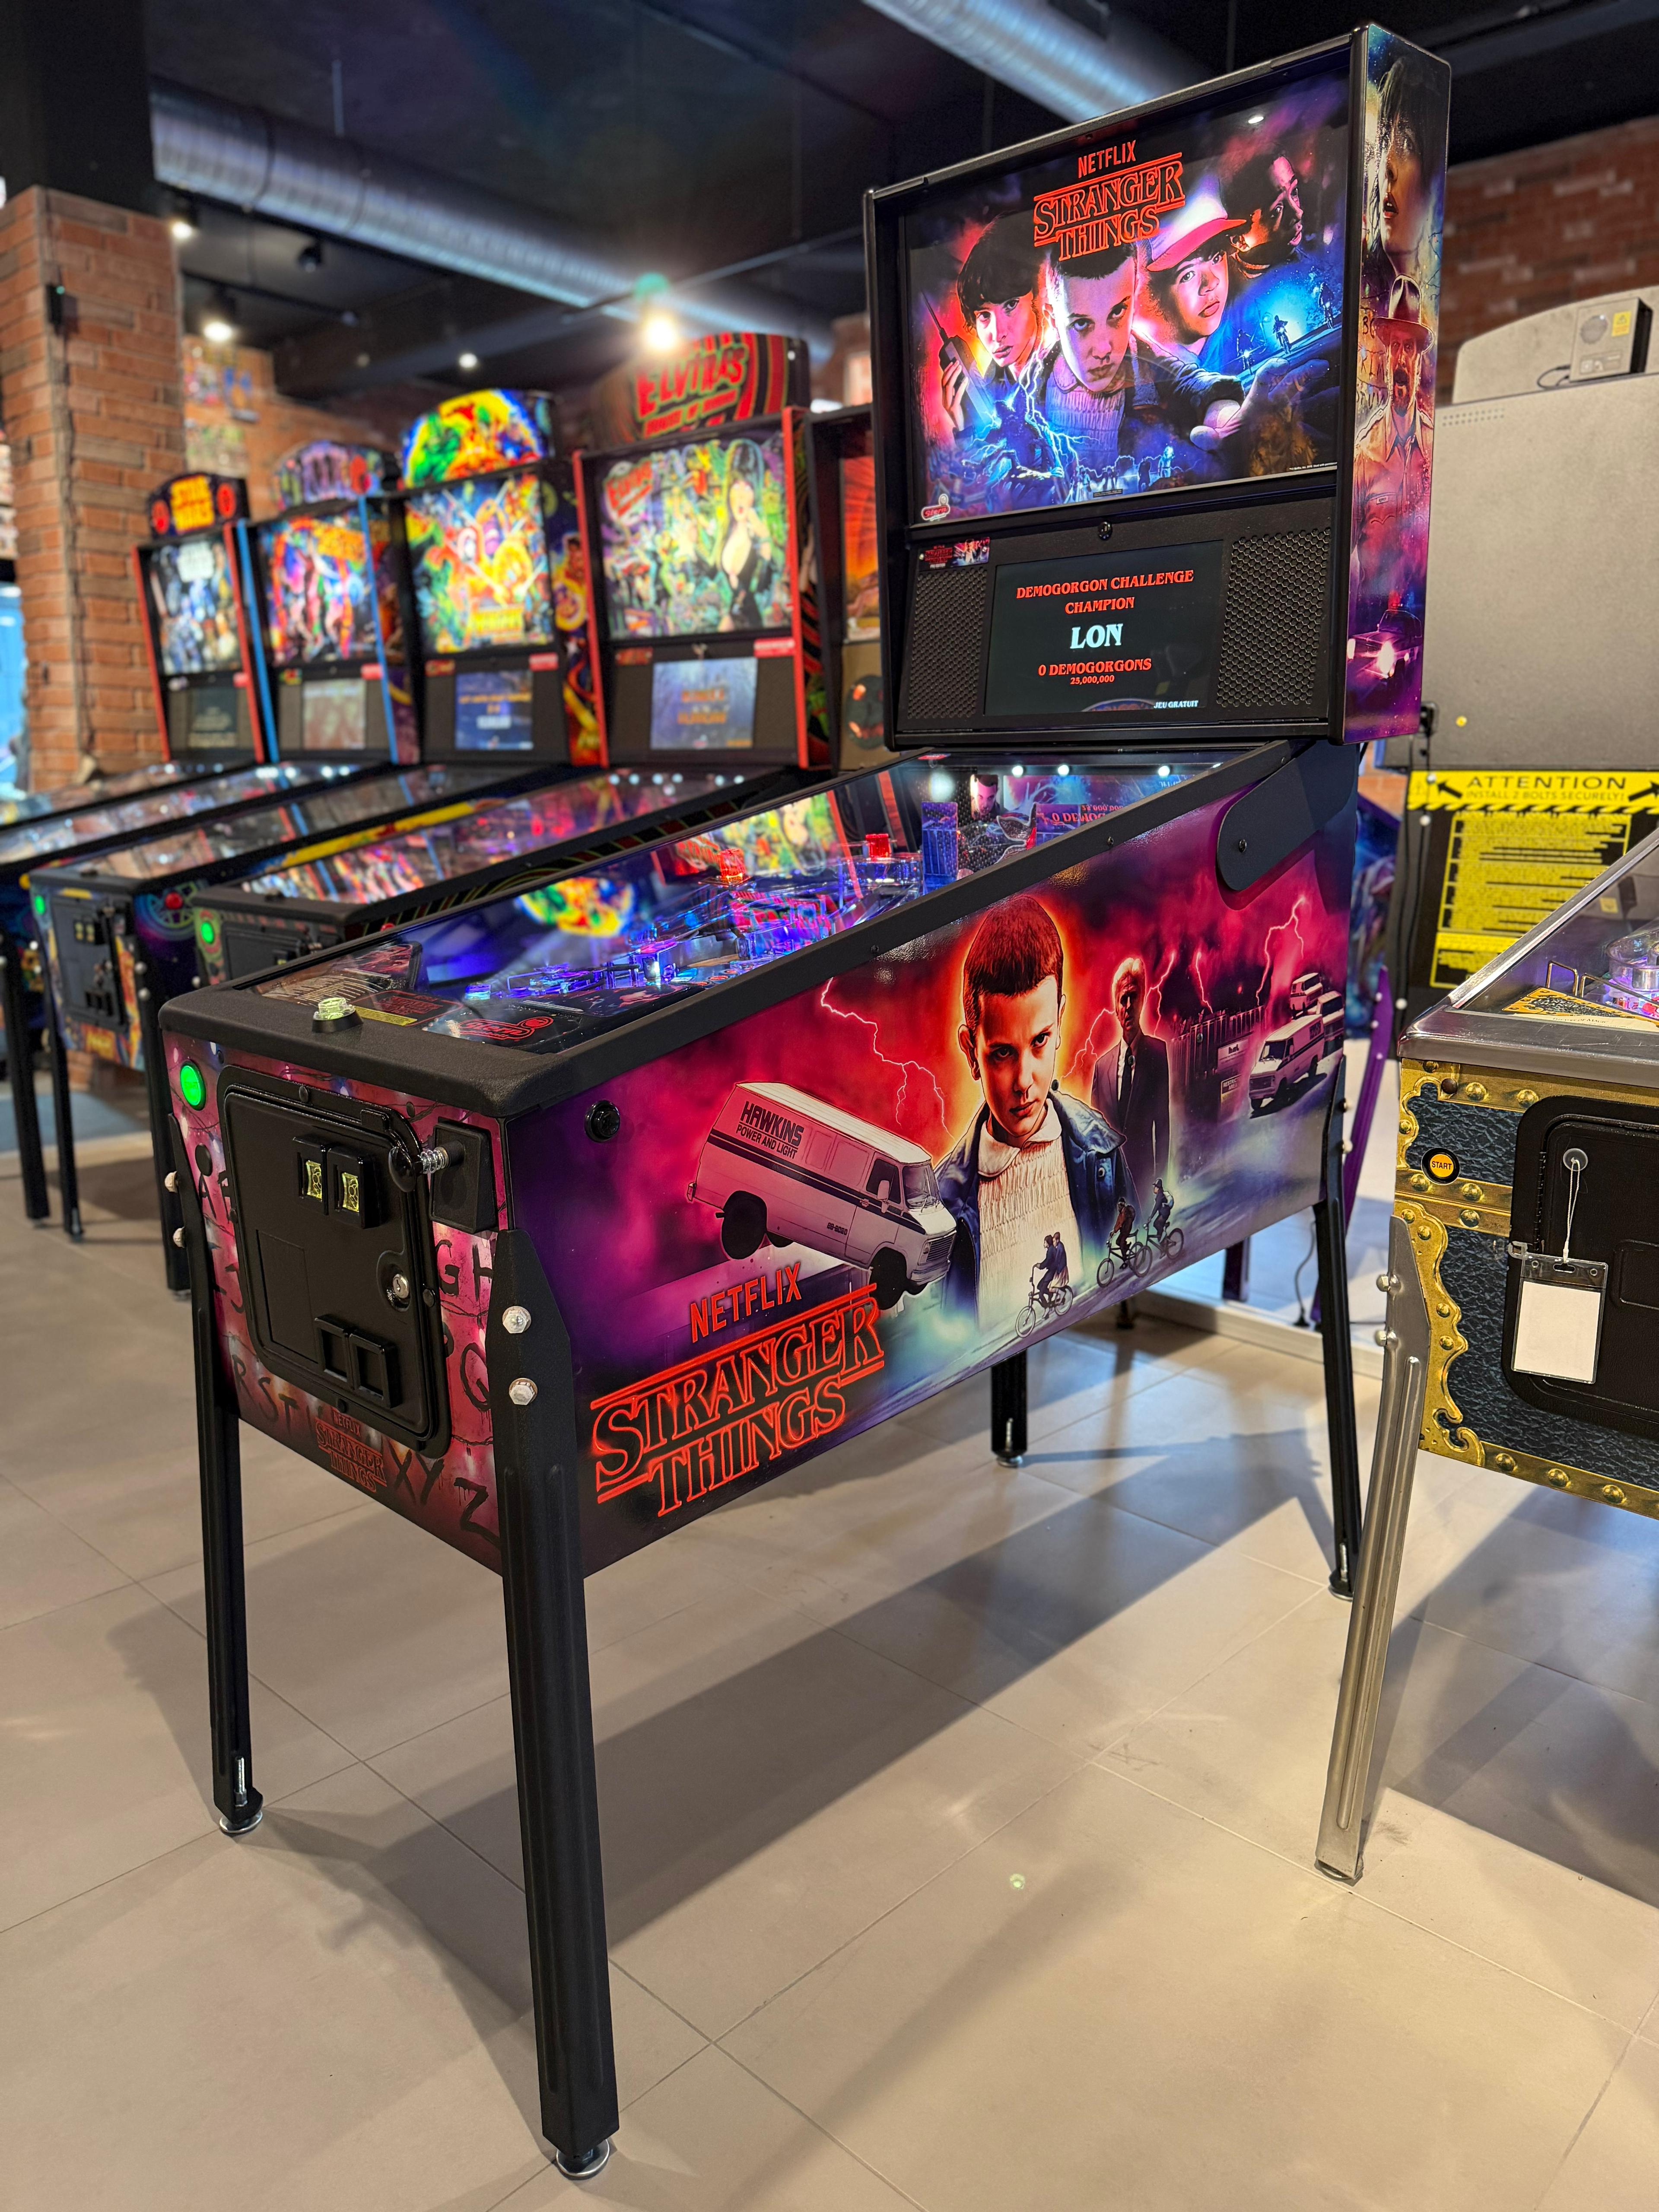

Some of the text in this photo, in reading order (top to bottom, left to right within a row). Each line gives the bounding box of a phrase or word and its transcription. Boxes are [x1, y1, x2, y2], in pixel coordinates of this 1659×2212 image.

[1078, 140, 1136, 178] NETFLIX
[1033, 161, 1185, 240] STRANGER
[1056, 205, 1160, 261] THINGS
[1016, 569, 1194, 599] DEMOGORGON CHALLENGE
[1065, 597, 1135, 614] CHAMPION
[1070, 623, 1123, 649] LON
[1049, 658, 1152, 676] DEMOGORGONS
[1070, 675, 1115, 685] 25,000,000
[1168, 699, 1199, 708] GRATUIT
[1467, 776, 1627, 789] ATTENTION
[736, 1124, 798, 1159] POWER AND LIGHT
[740, 1101, 804, 1147] HAWKINS
[1432, 1160, 1452, 1170] START
[690, 1263, 802, 1343] NETFLIX
[591, 1297, 884, 1492] STRANGER
[333, 1411, 361, 1437] NETFLIX
[316, 1421, 386, 1482] STRANGER
[650, 1376, 846, 1517] THINGS
[328, 1450, 377, 1493] THINGS
